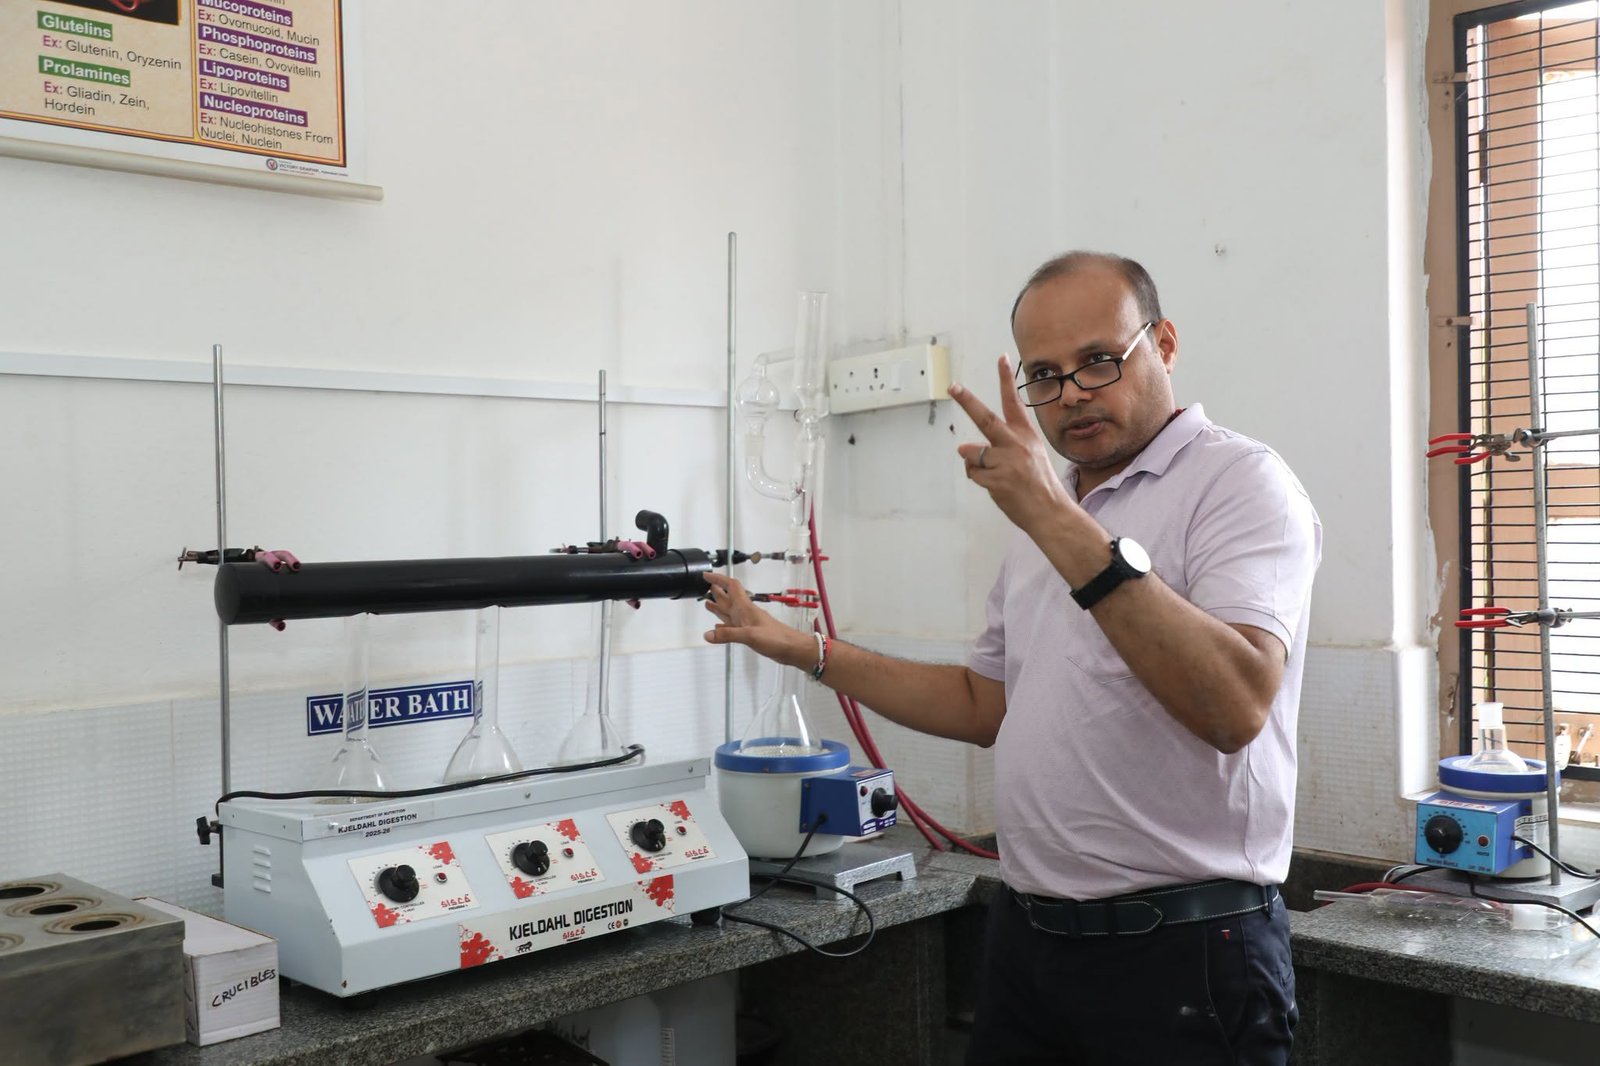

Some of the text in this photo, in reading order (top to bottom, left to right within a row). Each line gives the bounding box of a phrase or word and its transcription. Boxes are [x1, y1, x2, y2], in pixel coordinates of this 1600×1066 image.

[42, 15, 111, 38] Glutelins
[198, 9, 319, 46] Ex: Ovomucoid, Mucin
[43, 35, 182, 70] Ex: Glutenin, Oryzenin
[203, 26, 315, 62] Phosphoproteins
[44, 59, 130, 85] Prolamines
[199, 44, 321, 78] Ex: Casein, Ovovitellin
[203, 61, 287, 88] Lipoproteins
[44, 81, 150, 110] Ex: Gliadin, Zein,
[200, 79, 278, 103] Ex: Lipovitellin
[45, 98, 95, 116] Hordein
[204, 95, 305, 124] Nucleoproteins
[201, 112, 333, 144] Ex: Nucleohistones From
[201, 126, 282, 149] Nuclei, Nuclein
[408, 689, 469, 715] BATH
[338, 813, 417, 834] KJELDAHL DIGESTION
[509, 899, 633, 940] KJELDAHL DIGESTION
[212, 969, 276, 1007] CRUCIBLES
